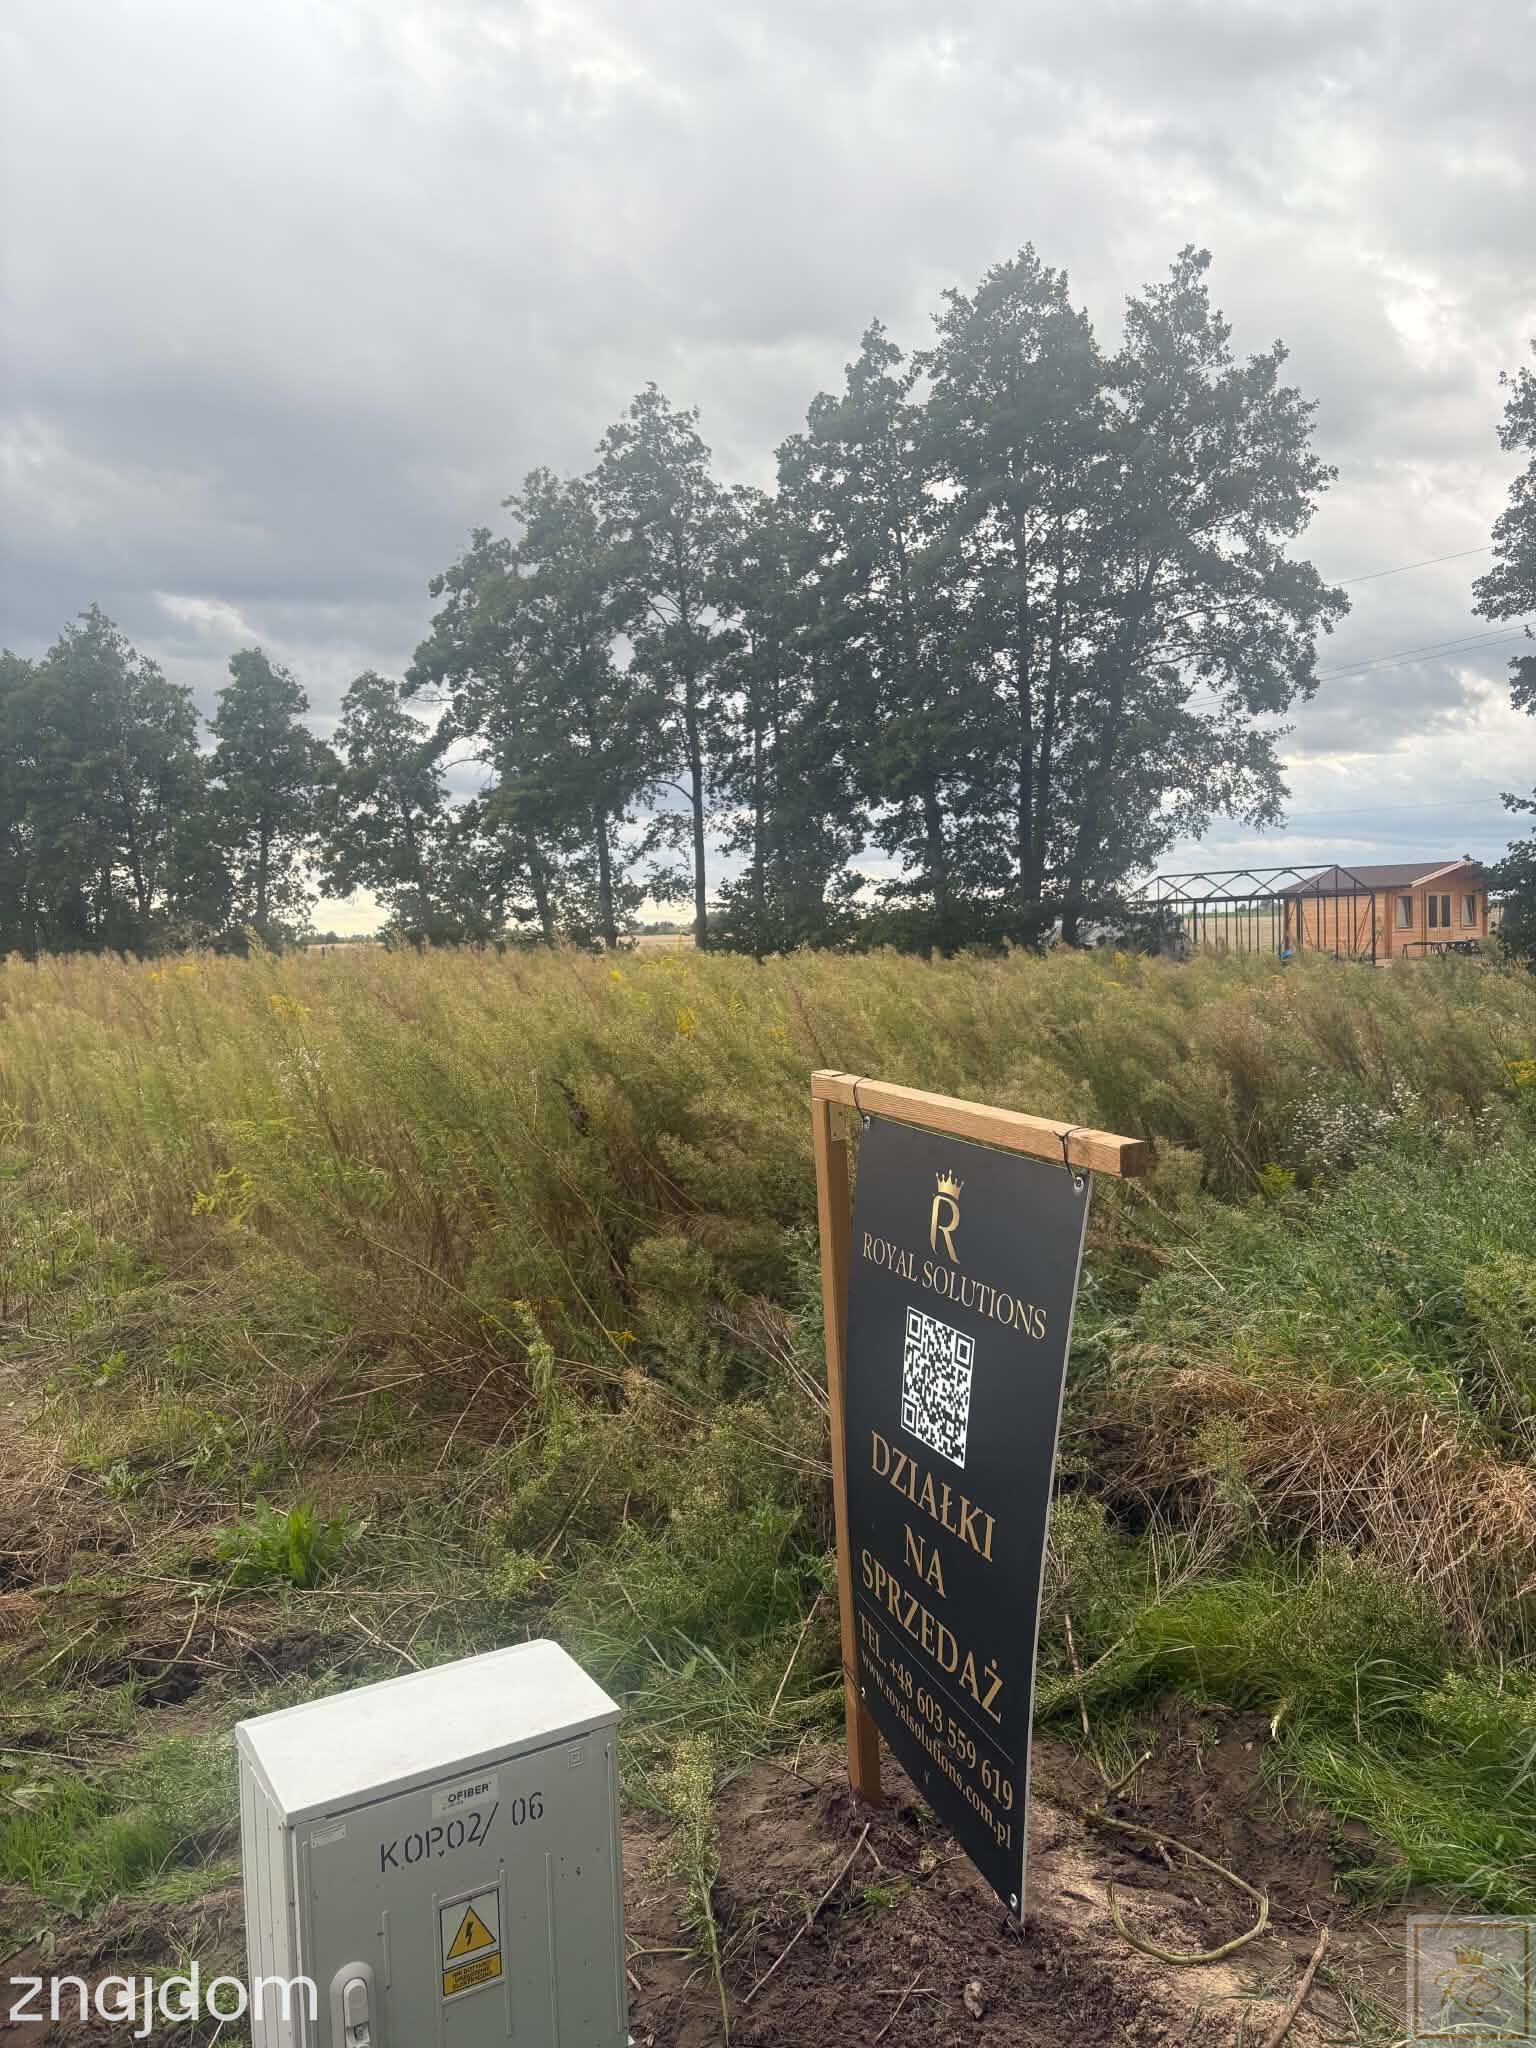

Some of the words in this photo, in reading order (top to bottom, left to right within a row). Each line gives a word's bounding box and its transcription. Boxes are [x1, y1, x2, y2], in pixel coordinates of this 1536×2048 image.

[863, 1232, 917, 1281] ROYAL
[923, 1261, 1047, 1340] SOLUTIONS
[930, 1195, 960, 1264] R
[871, 1431, 996, 1563] DZIAŁKI
[904, 1523, 946, 1599] NA
[861, 1549, 1004, 1724] SPRZEDAŻ
[861, 1648, 1011, 1849] www.royalsolutions.com.pl
[889, 1659, 913, 1699] +48
[917, 1687, 943, 1733] 603
[949, 1718, 977, 1769] 559
[981, 1759, 1014, 1811] 619
[511, 1791, 544, 1826] 06
